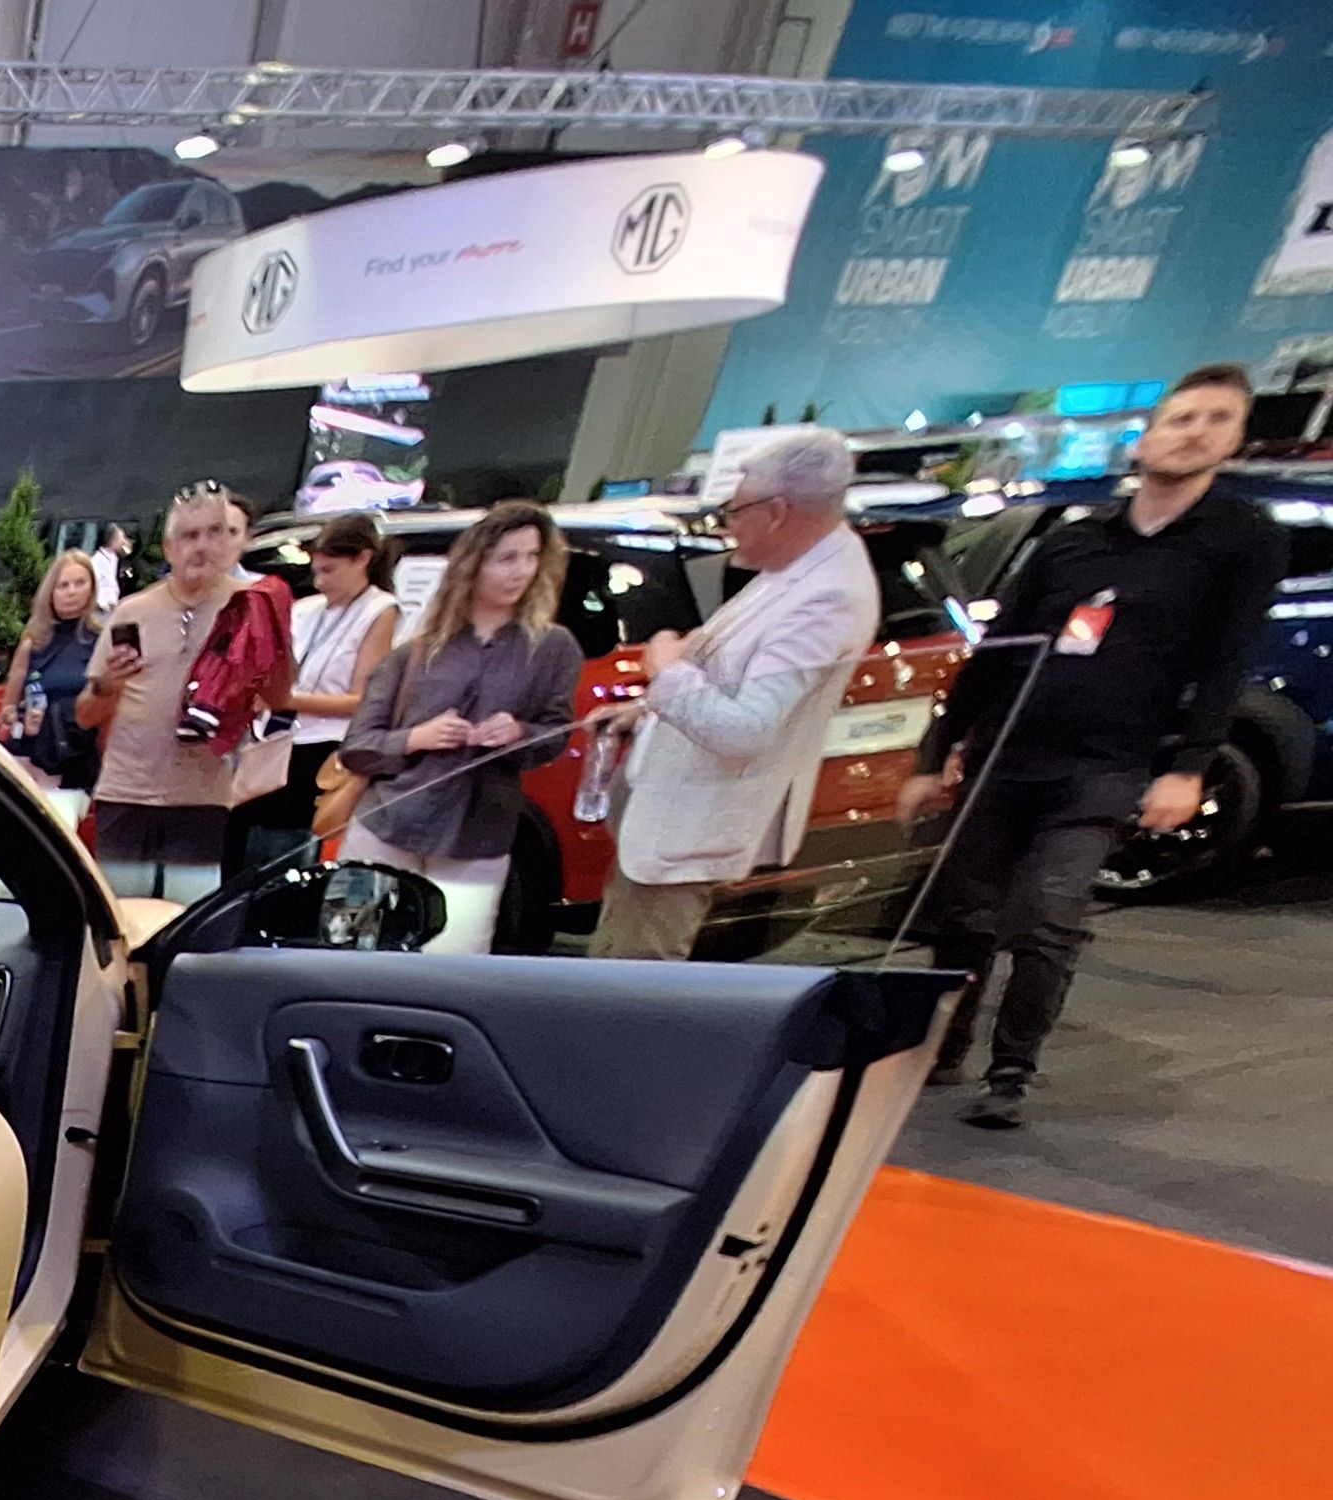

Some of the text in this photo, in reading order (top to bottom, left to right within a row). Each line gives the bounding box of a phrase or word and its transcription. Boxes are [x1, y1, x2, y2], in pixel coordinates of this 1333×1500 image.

[613, 185, 689, 271] MG
[364, 254, 405, 279] Find
[409, 248, 452, 275] your
